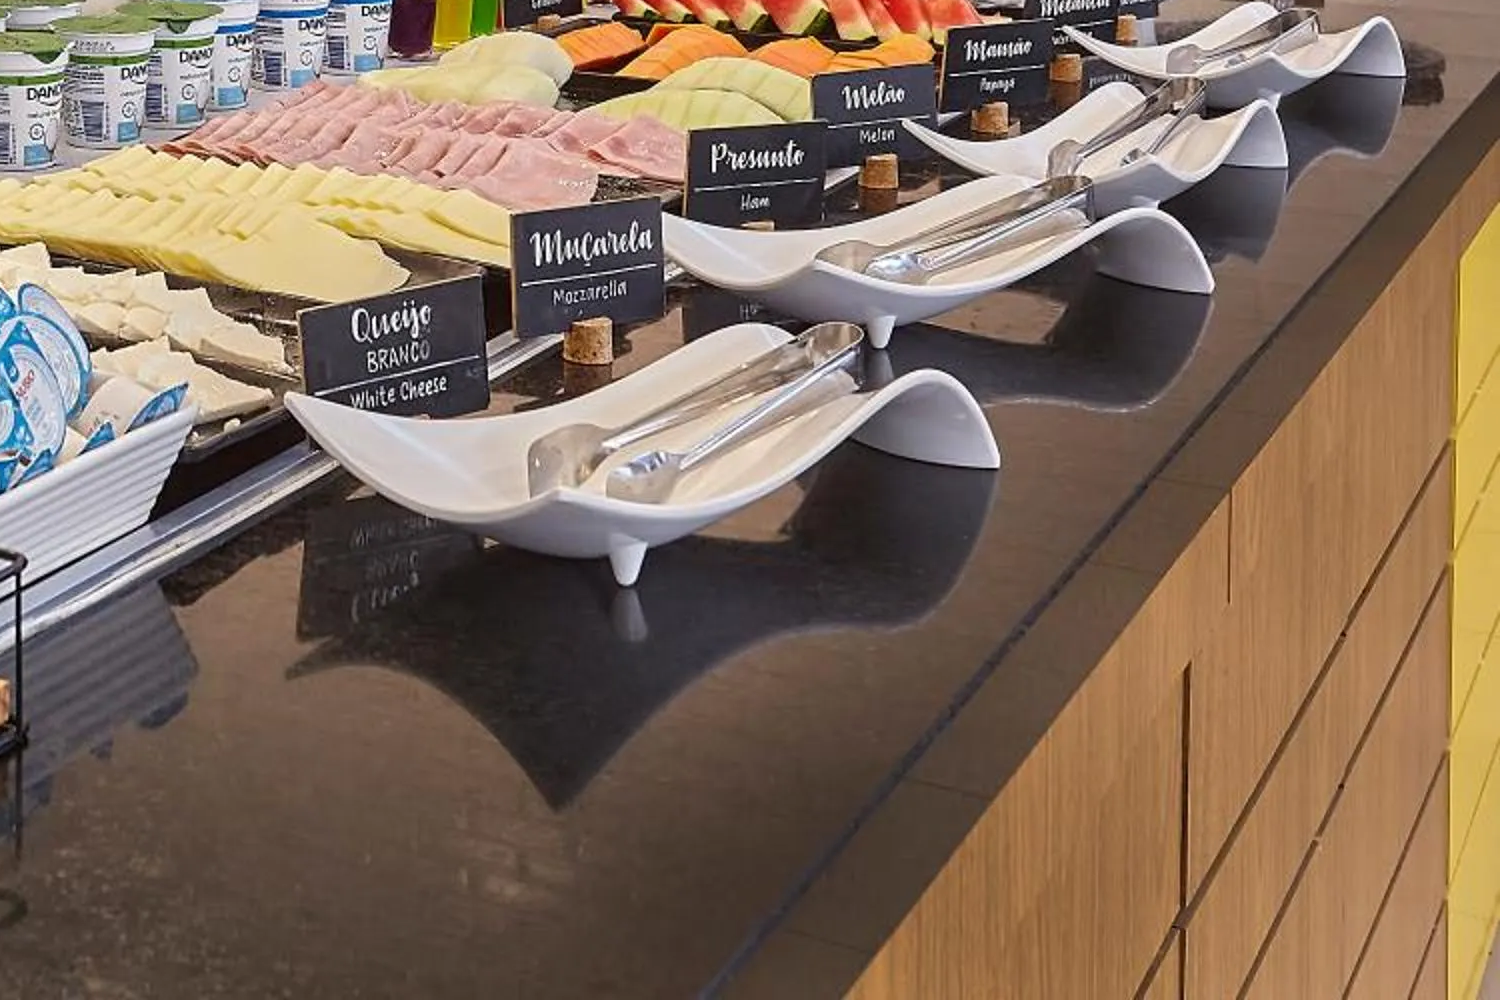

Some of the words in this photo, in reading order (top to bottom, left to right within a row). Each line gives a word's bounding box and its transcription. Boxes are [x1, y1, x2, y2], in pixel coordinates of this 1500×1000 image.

[963, 37, 1033, 62] Mamão
[841, 81, 905, 110] Melão
[859, 129, 896, 144] Melon
[710, 139, 805, 174] Presunto
[740, 193, 771, 211] Ham
[529, 219, 654, 268] Muçarela
[552, 280, 628, 306] Mozzarella
[351, 300, 432, 343] Queijo
[367, 339, 431, 374] BRANCO
[351, 388, 396, 410] White
[399, 375, 448, 401] Cheese
